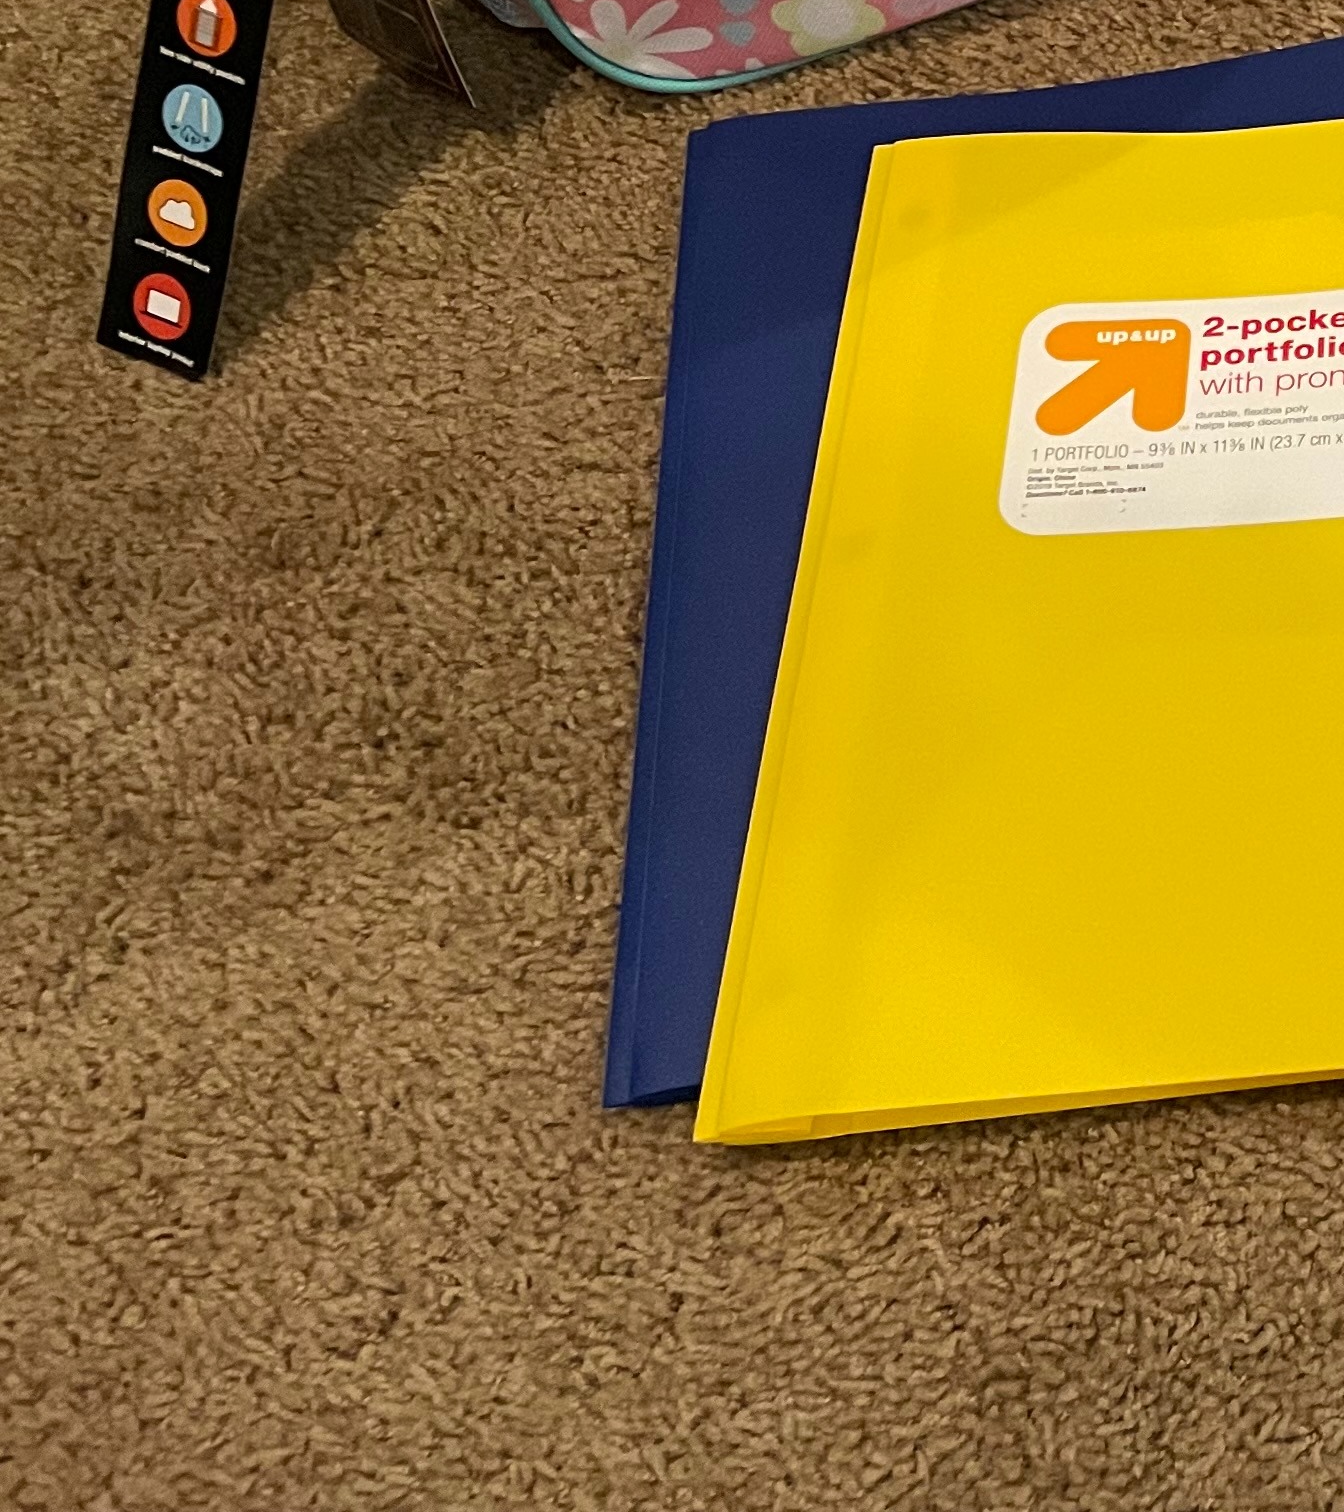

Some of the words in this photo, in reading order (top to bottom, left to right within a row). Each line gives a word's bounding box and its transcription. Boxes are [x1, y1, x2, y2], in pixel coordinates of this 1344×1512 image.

[1097, 328, 1176, 347] up&up
[1199, 371, 1264, 396] with
[1284, 405, 1309, 415] poly
[1195, 421, 1225, 431] helps
[1227, 418, 1255, 429] keep
[1257, 414, 1319, 427] documents
[1044, 443, 1129, 462] PORTFOLIO
[1180, 440, 1196, 456] IN
[1199, 443, 1208, 454] x
[1250, 436, 1266, 451] IN
[1270, 433, 1306, 452] (23.7
[1310, 434, 1331, 446] cm
[1335, 433, 1344, 445] x
